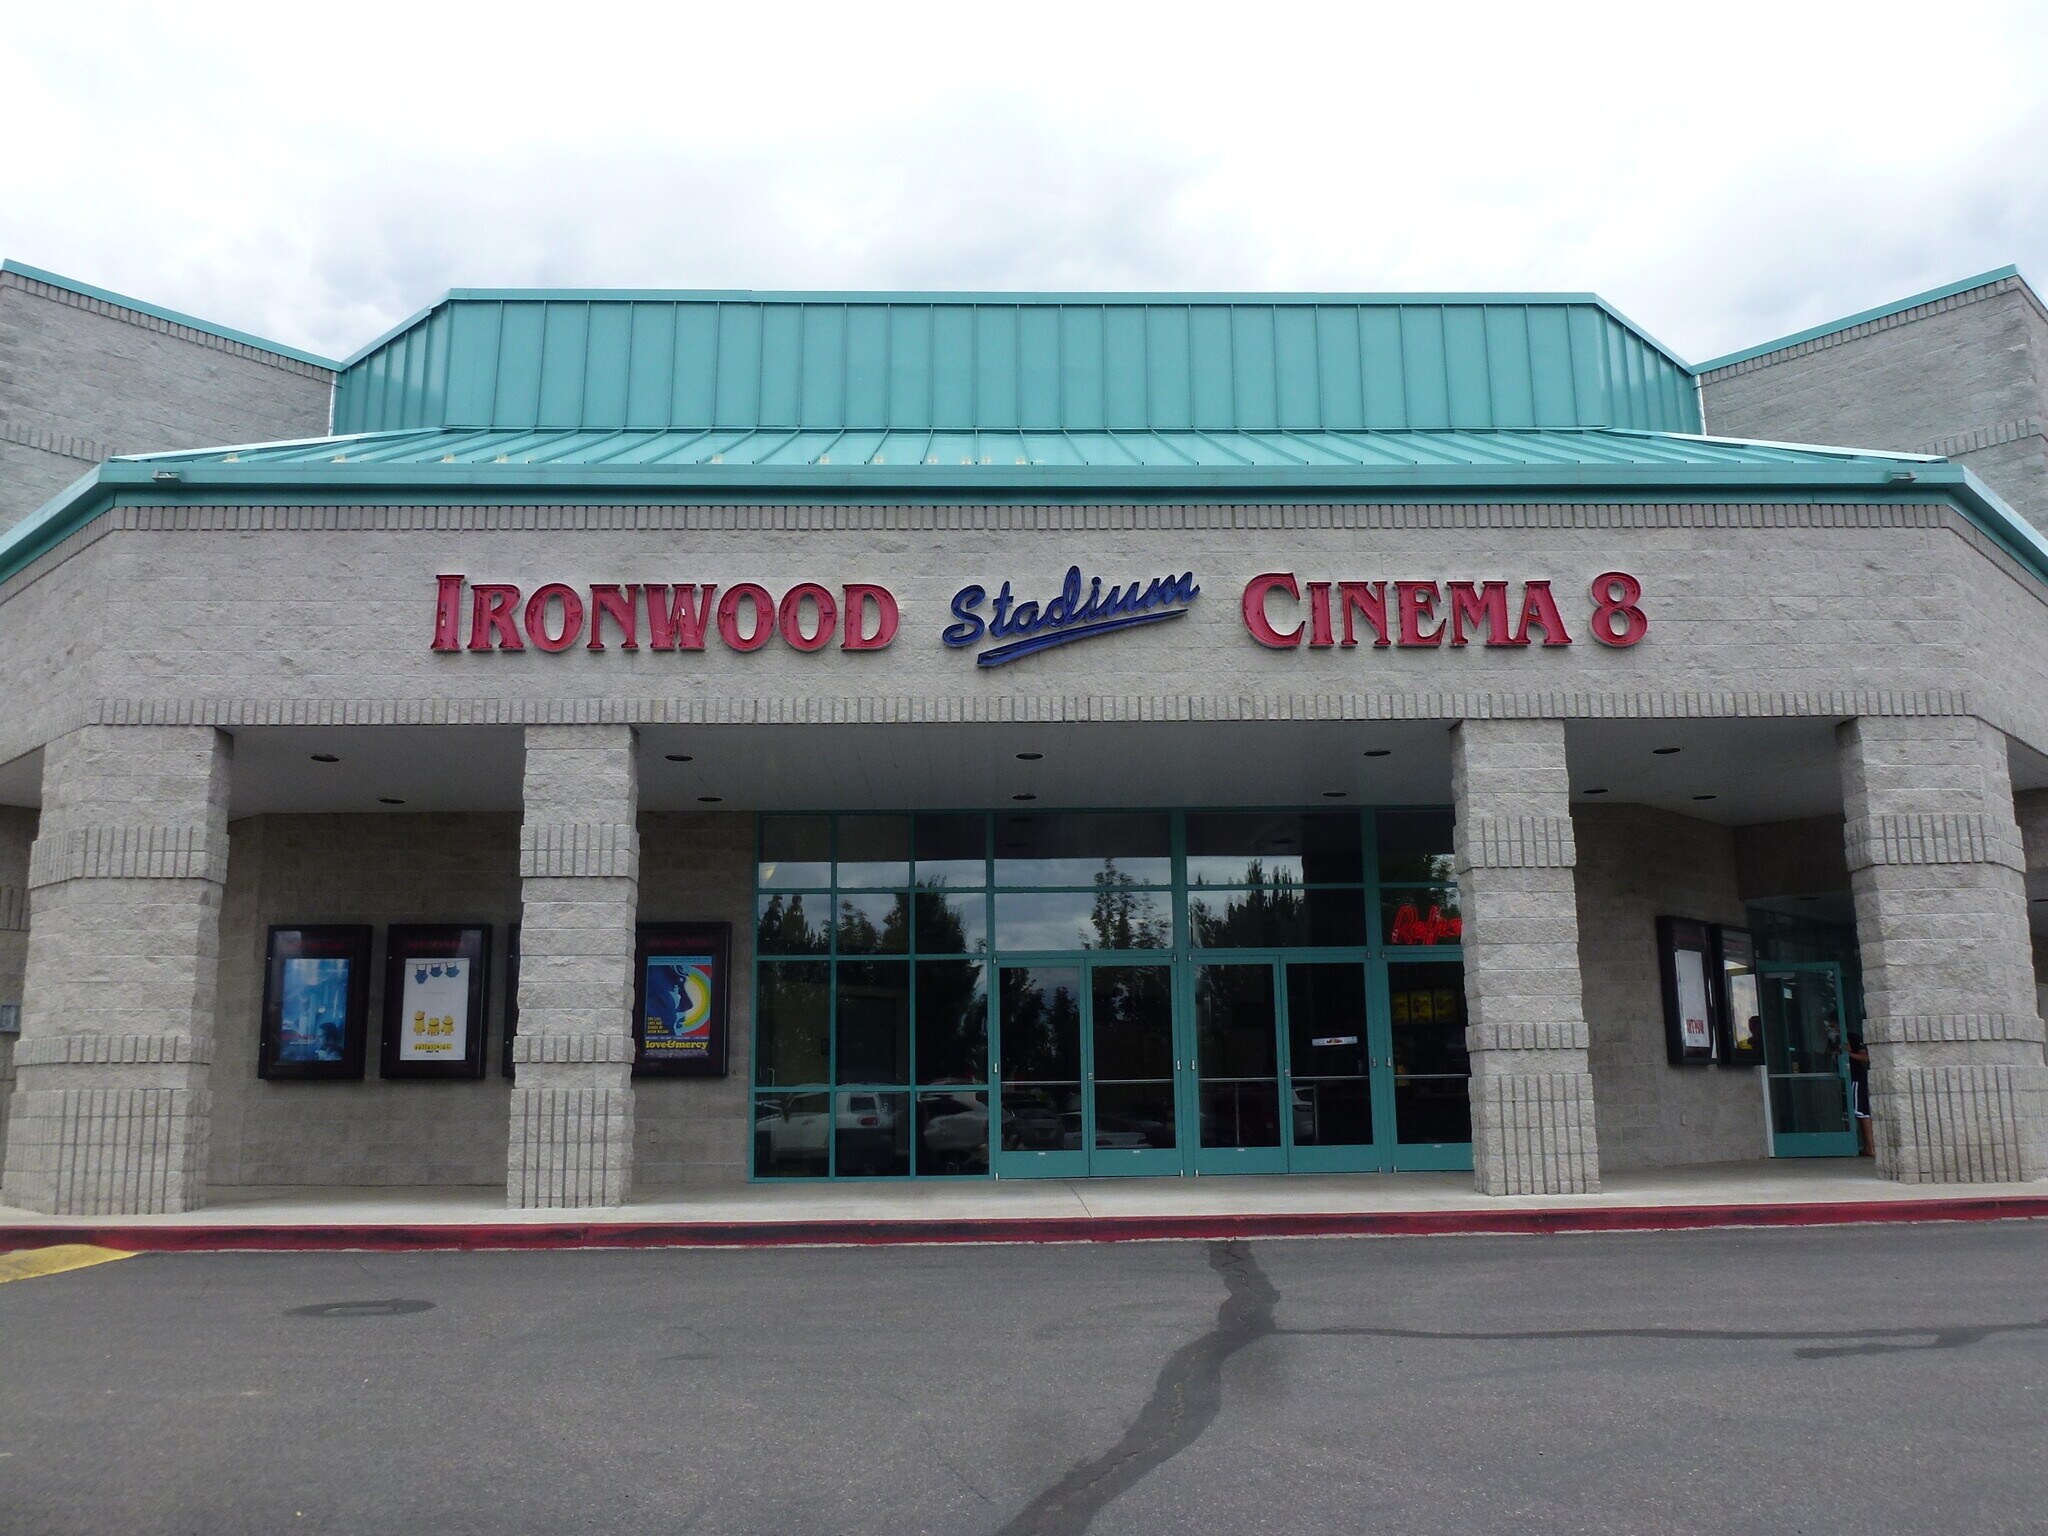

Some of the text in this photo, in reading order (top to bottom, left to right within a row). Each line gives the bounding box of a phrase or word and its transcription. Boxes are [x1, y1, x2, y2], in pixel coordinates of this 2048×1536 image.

[430, 565, 1648, 652] IRONWOOD Stadium CINEMA 8
